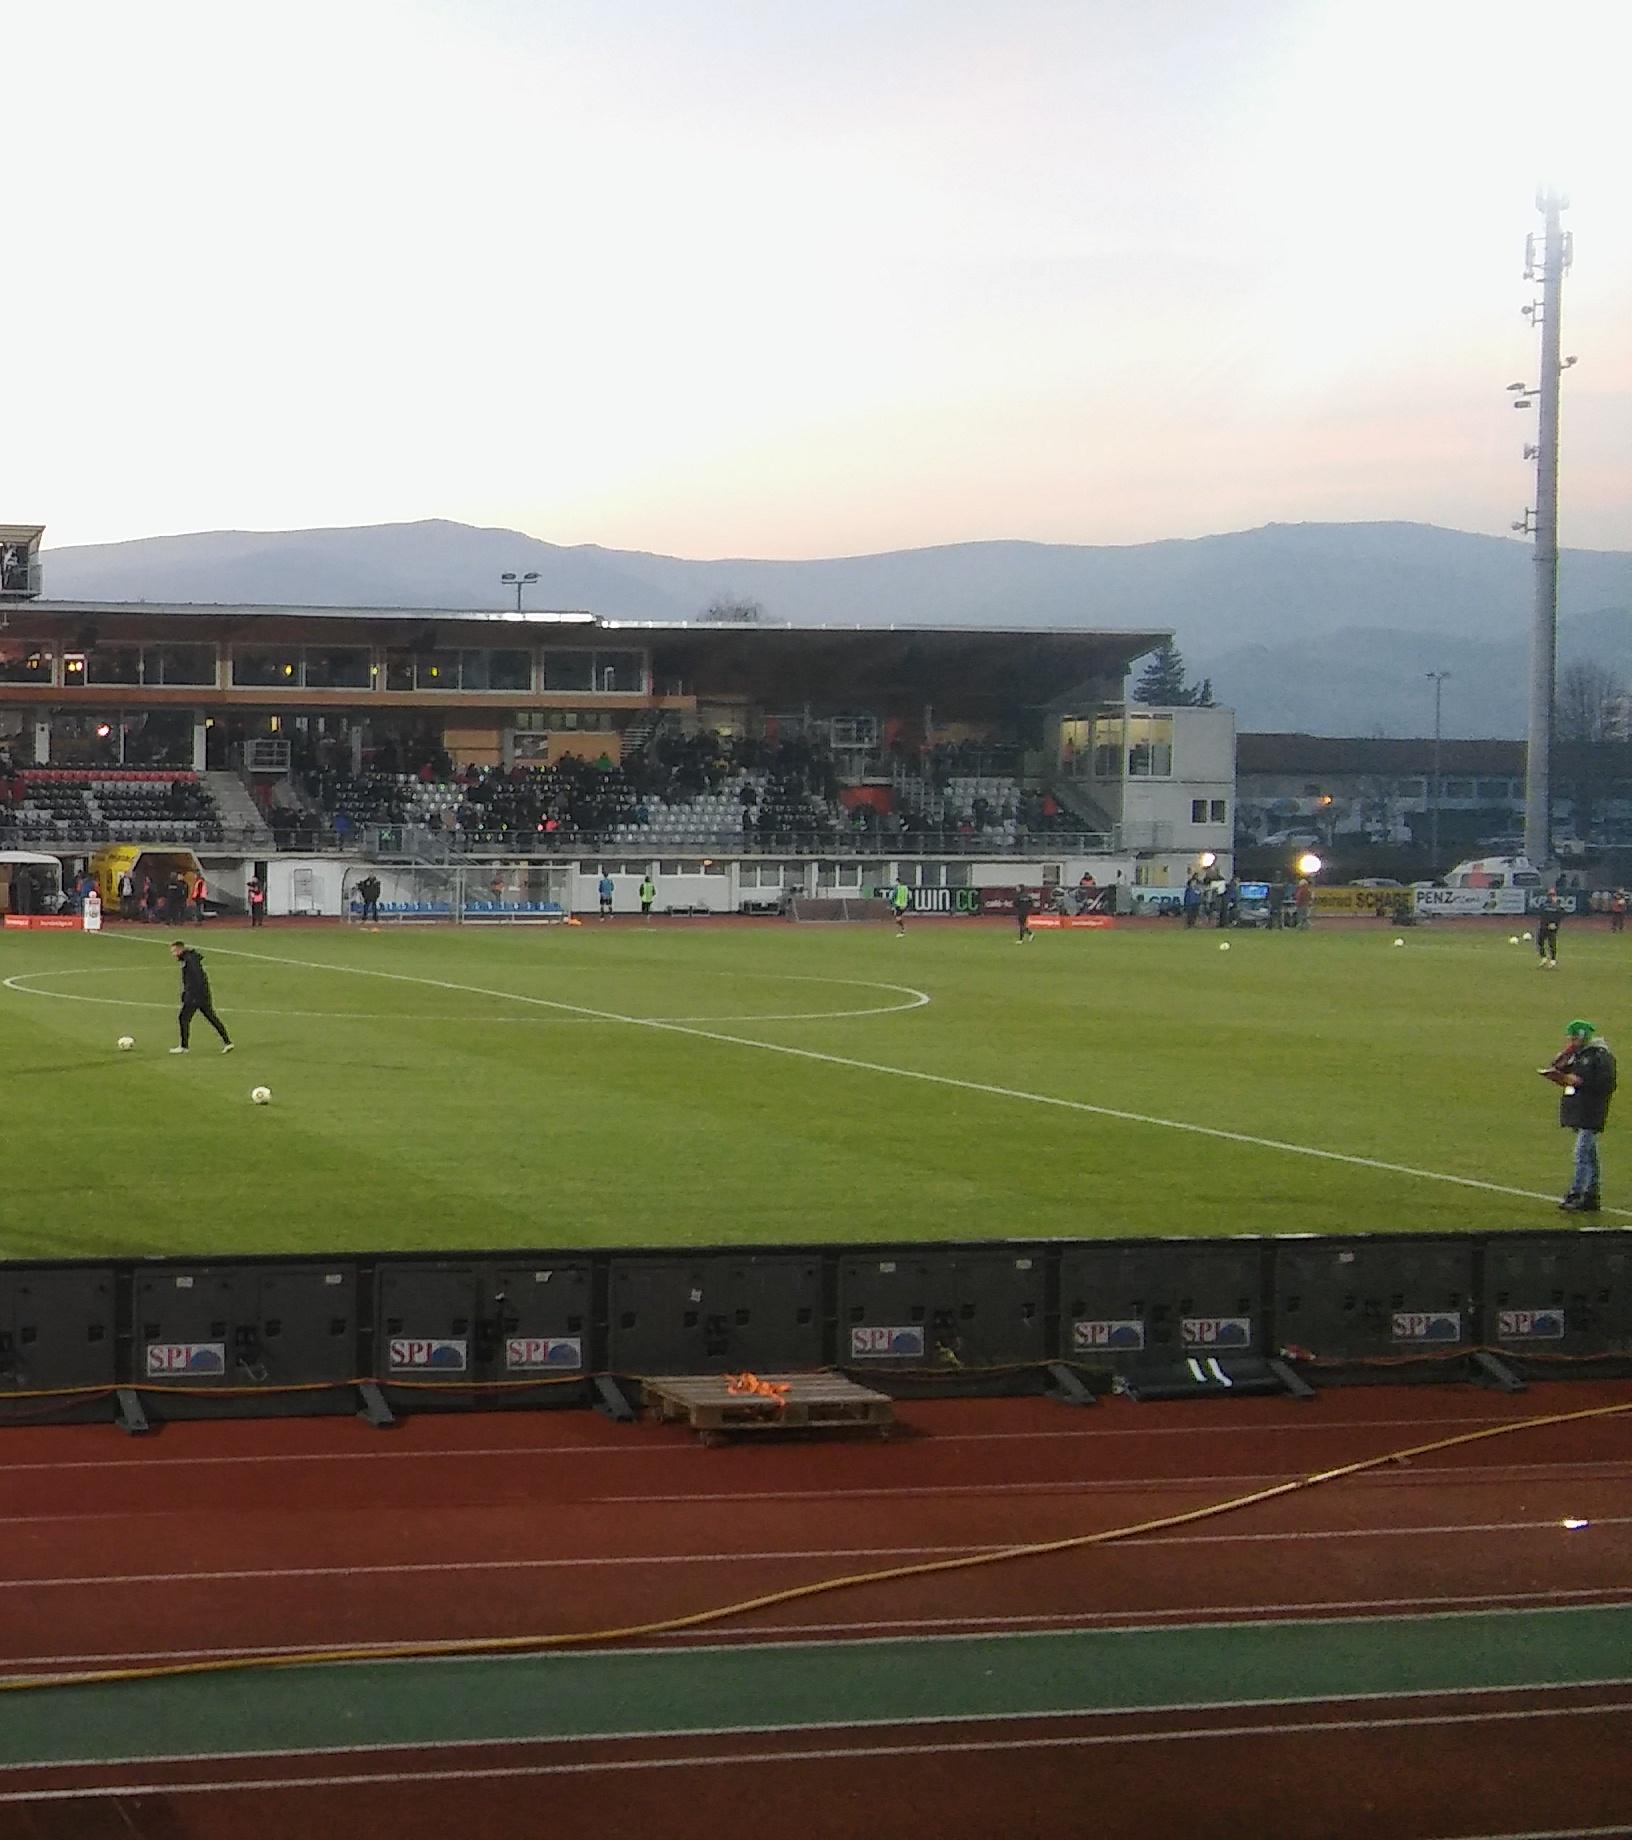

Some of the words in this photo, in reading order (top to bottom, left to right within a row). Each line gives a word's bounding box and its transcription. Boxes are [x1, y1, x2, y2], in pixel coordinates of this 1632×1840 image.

[1416, 891, 1454, 905] PENZ
[509, 1340, 549, 1362] SPI
[855, 1329, 893, 1351] SPI
[150, 1346, 192, 1368] SPI
[391, 1342, 433, 1364] SPI
